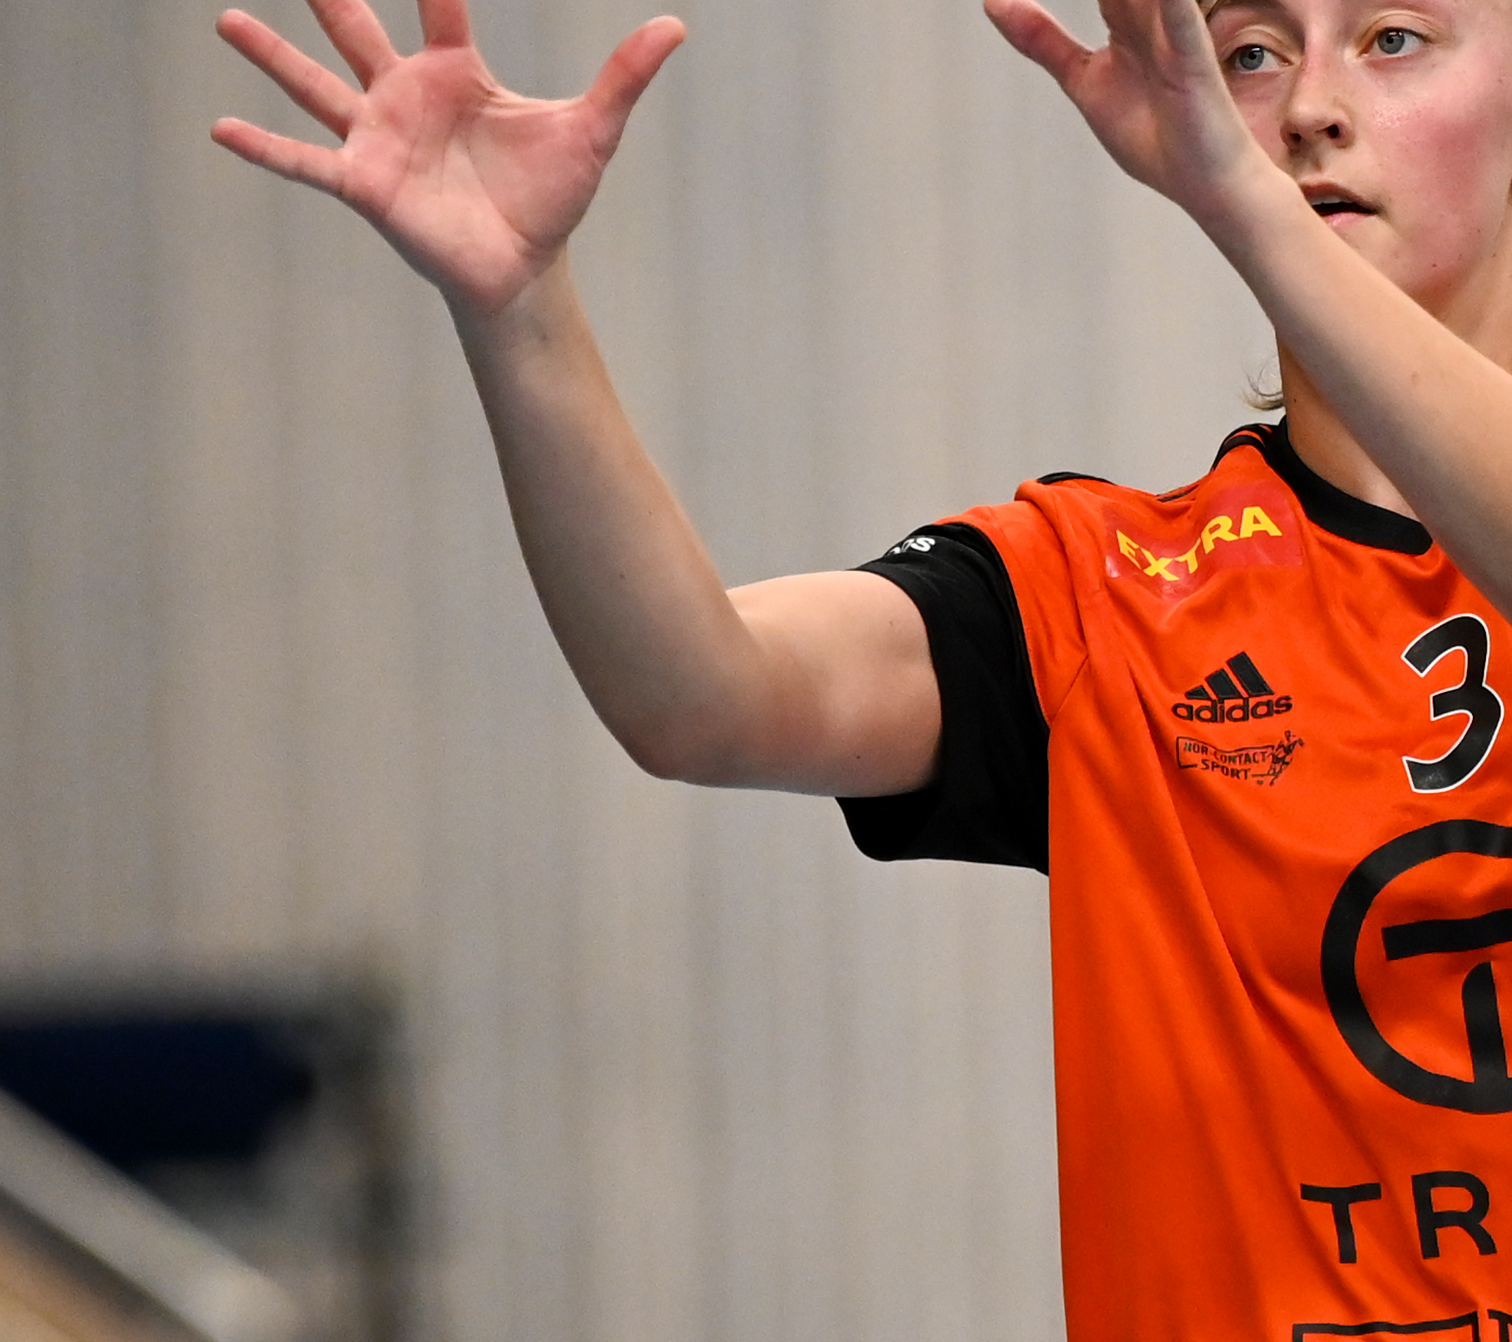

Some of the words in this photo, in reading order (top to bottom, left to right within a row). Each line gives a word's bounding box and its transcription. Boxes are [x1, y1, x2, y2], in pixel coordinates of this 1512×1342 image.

[1116, 506, 1283, 582] EXTRA
[1171, 692, 1294, 724] adidas
[1401, 612, 1505, 794] 3
[1201, 758, 1252, 781] SPORT
